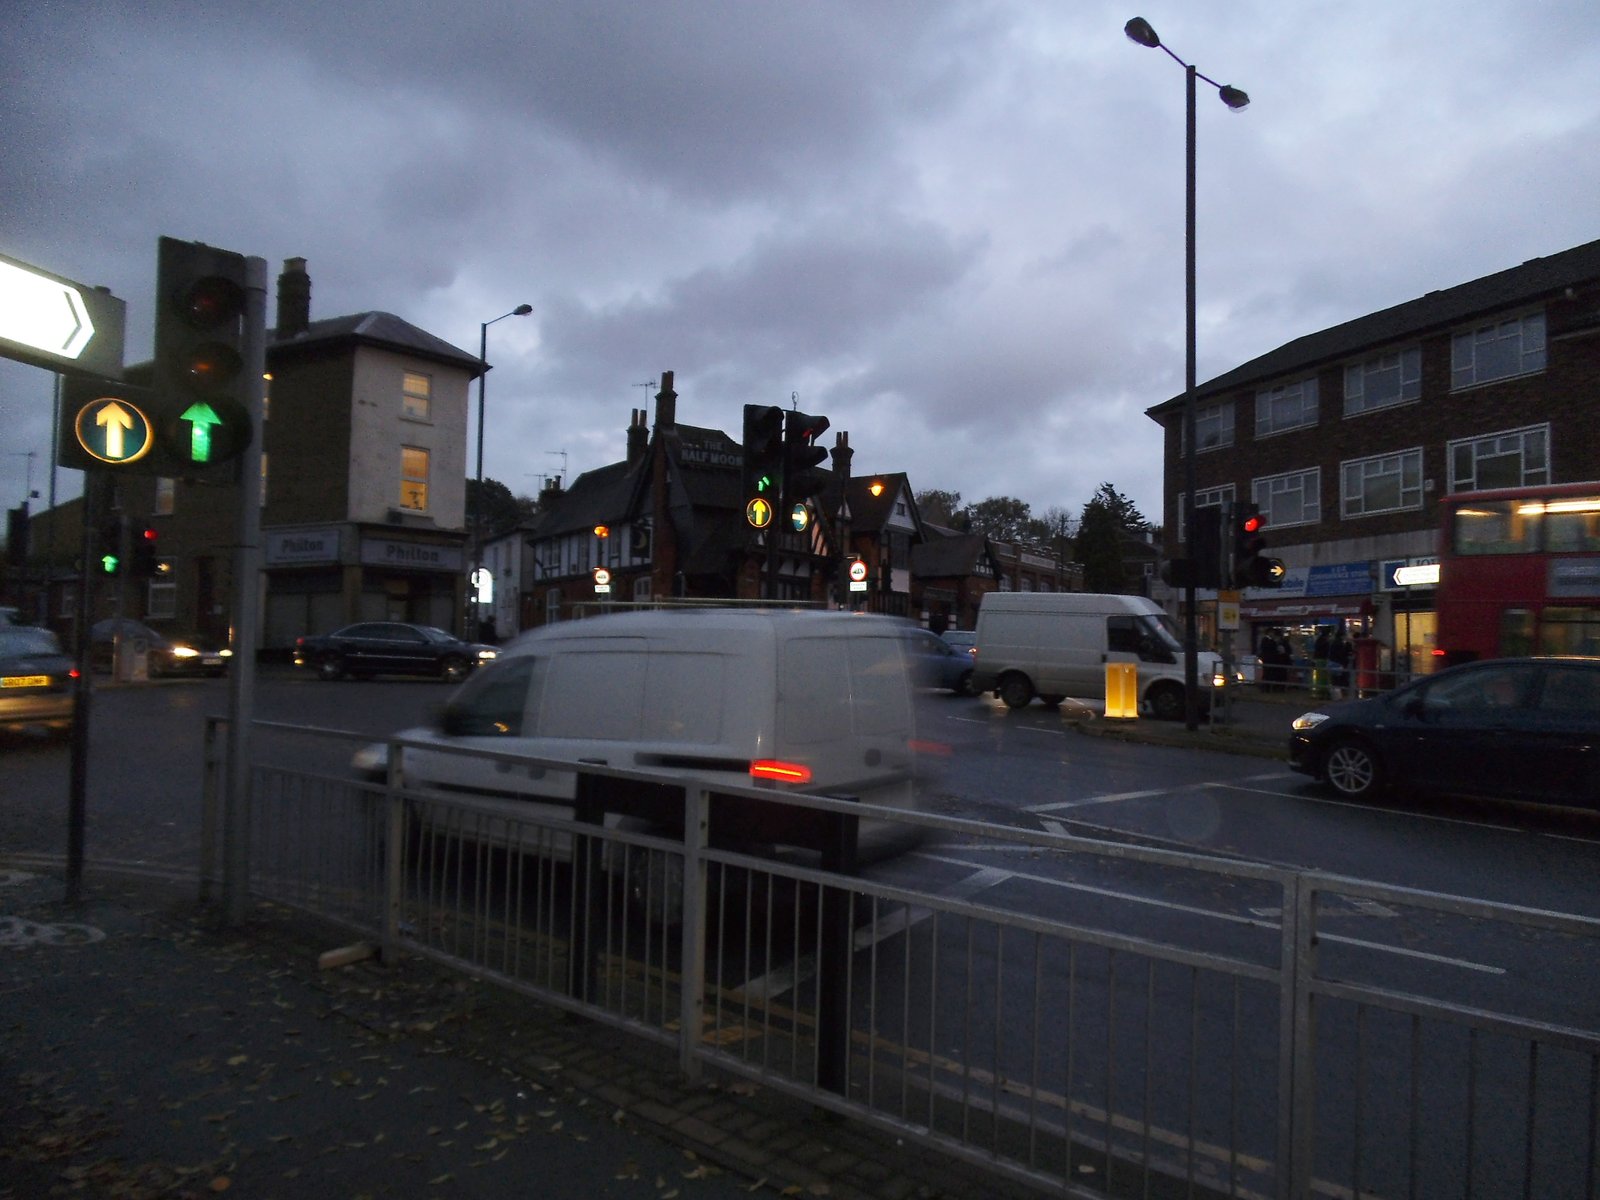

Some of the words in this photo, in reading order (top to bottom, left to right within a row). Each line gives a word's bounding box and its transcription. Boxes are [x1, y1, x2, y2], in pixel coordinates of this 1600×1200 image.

[704, 440, 722, 450] THE
[682, 449, 708, 462] HALF
[386, 544, 439, 562] Philton
